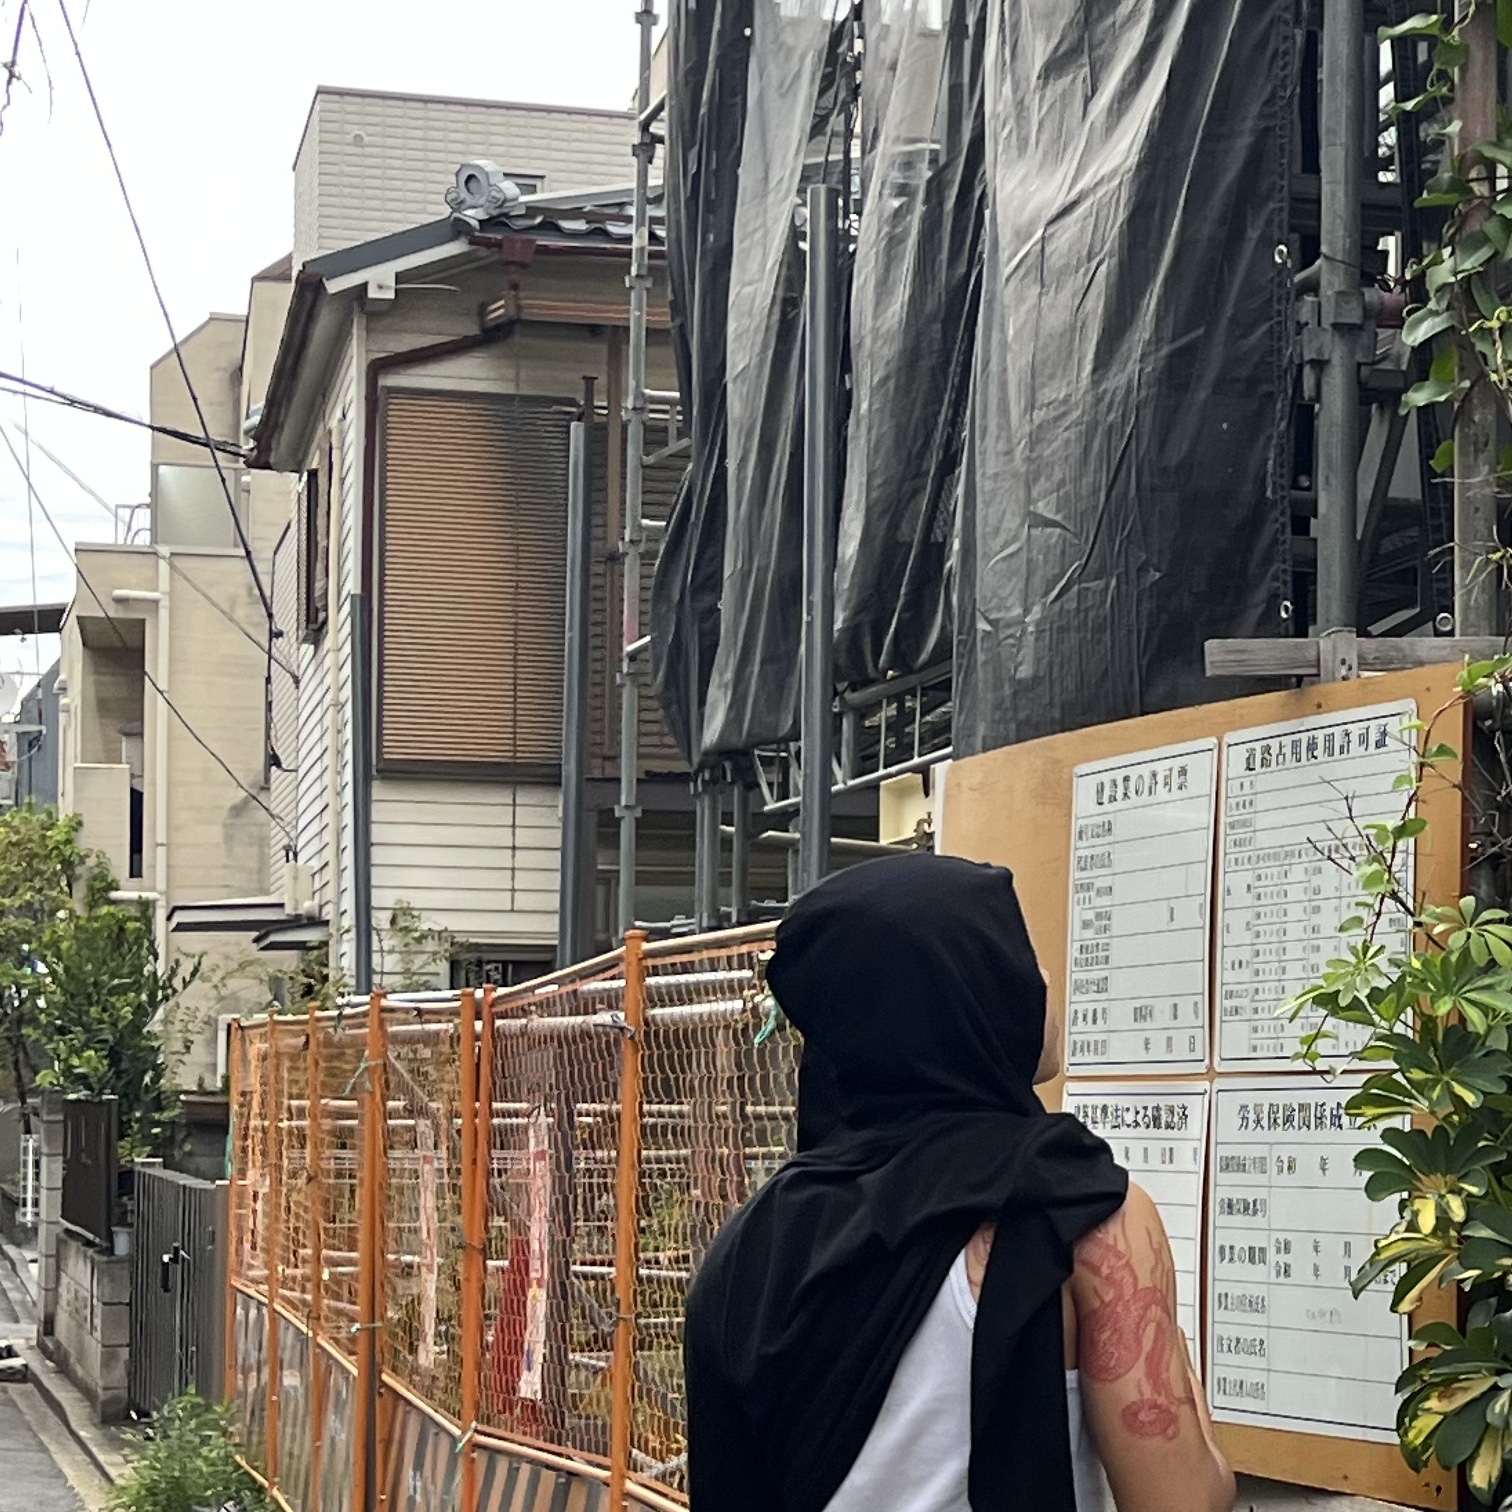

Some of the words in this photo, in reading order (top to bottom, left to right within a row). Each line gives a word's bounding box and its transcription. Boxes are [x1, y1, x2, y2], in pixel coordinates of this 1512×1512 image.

[1244, 722, 1389, 772] 道路占用使用許可証
[1095, 763, 1189, 806] 建設業の許可票
